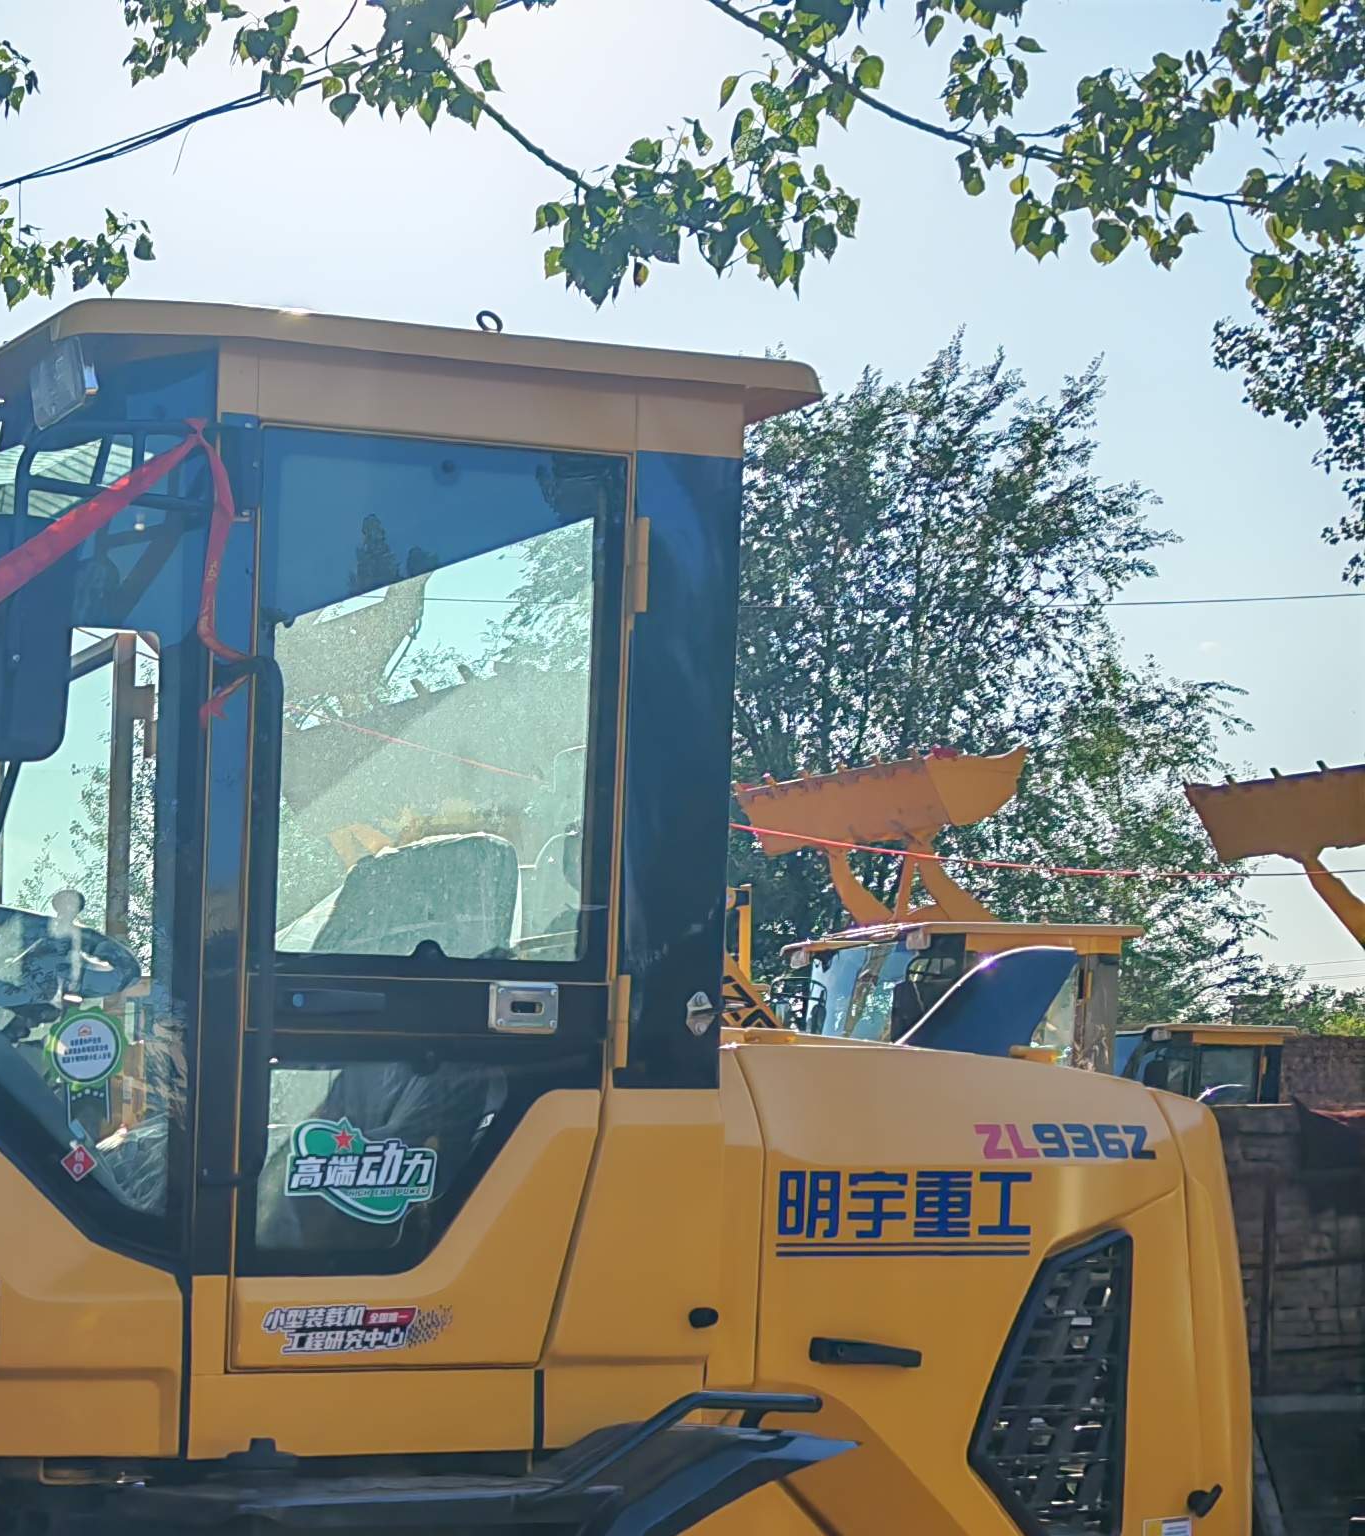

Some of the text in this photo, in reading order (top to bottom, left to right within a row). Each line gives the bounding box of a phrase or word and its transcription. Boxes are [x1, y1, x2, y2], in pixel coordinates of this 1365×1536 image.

[974, 1124, 1157, 1160] ZL936Z
[290, 1142, 433, 1190] 高端动力
[777, 1171, 1032, 1239] 明宇重工
[263, 1306, 365, 1330] 小型装载机
[282, 1328, 405, 1352] 工程研究中心
